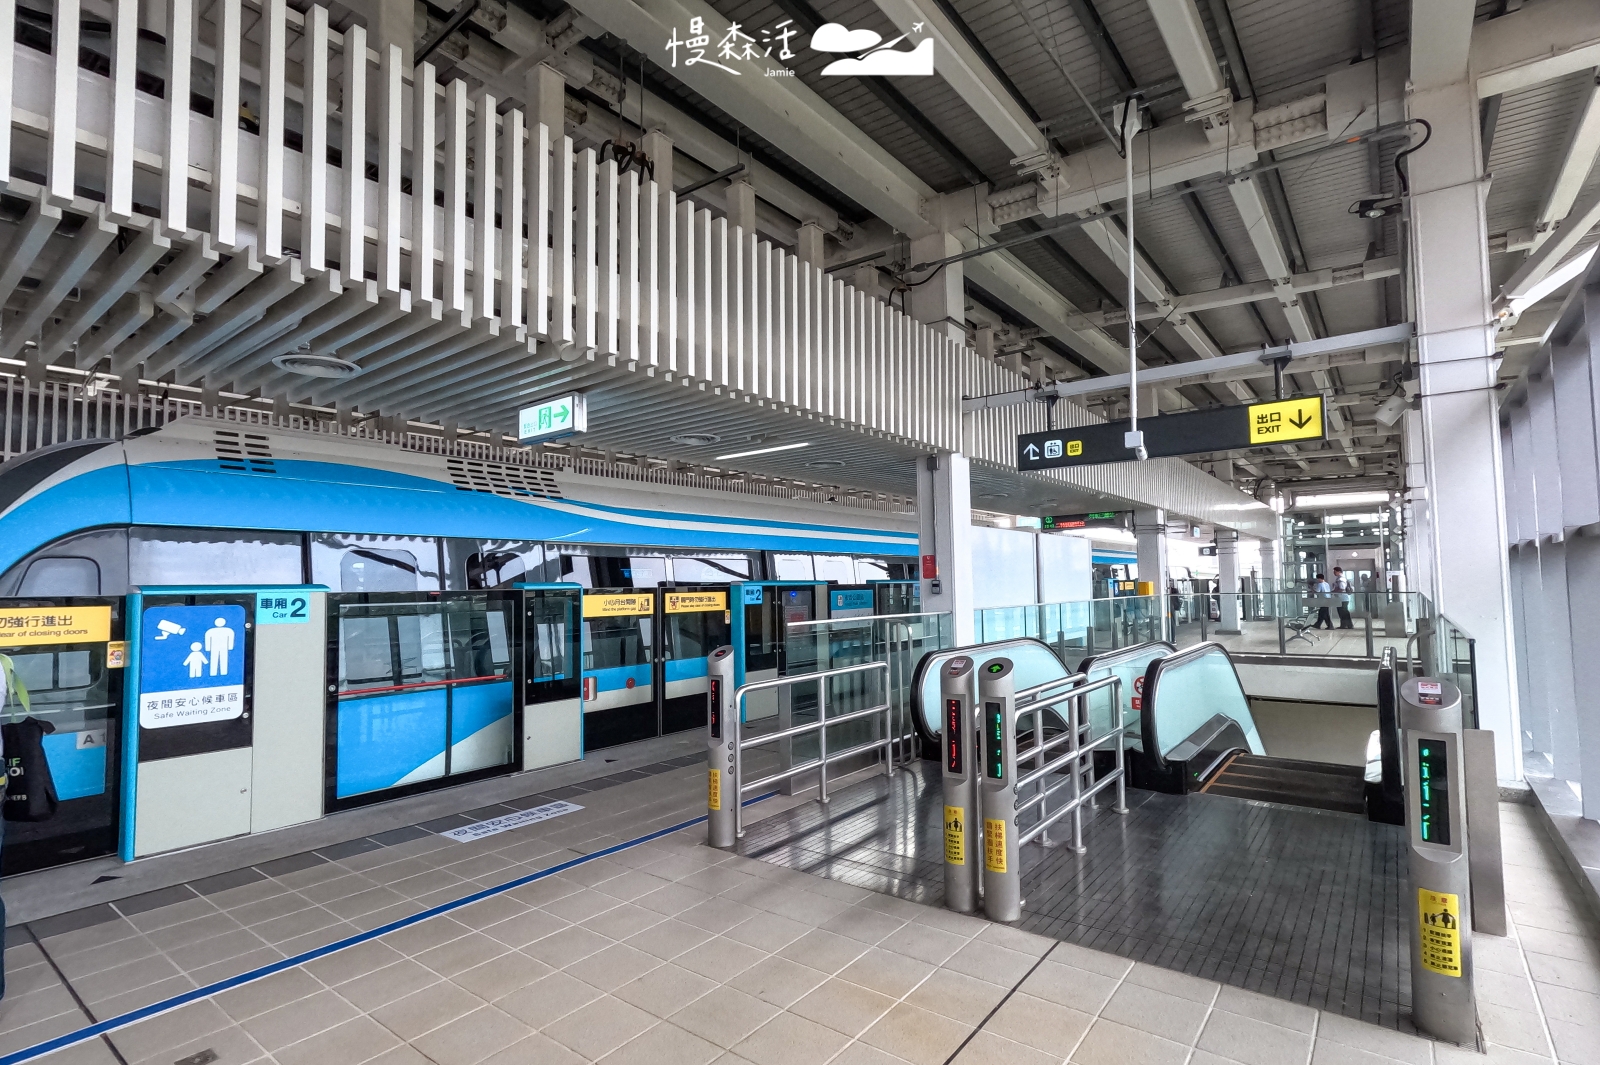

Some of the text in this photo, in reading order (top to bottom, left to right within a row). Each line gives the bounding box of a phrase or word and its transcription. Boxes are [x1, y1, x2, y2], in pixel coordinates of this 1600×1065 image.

[1257, 412, 1281, 424] 出口
[1257, 425, 1281, 434] EXIT
[756, 589, 761, 600] 2
[260, 598, 306, 618] 車廂 2
[147, 693, 238, 711] 夜間安心候車區
[154, 706, 231, 719] Safe Waiting Zone
